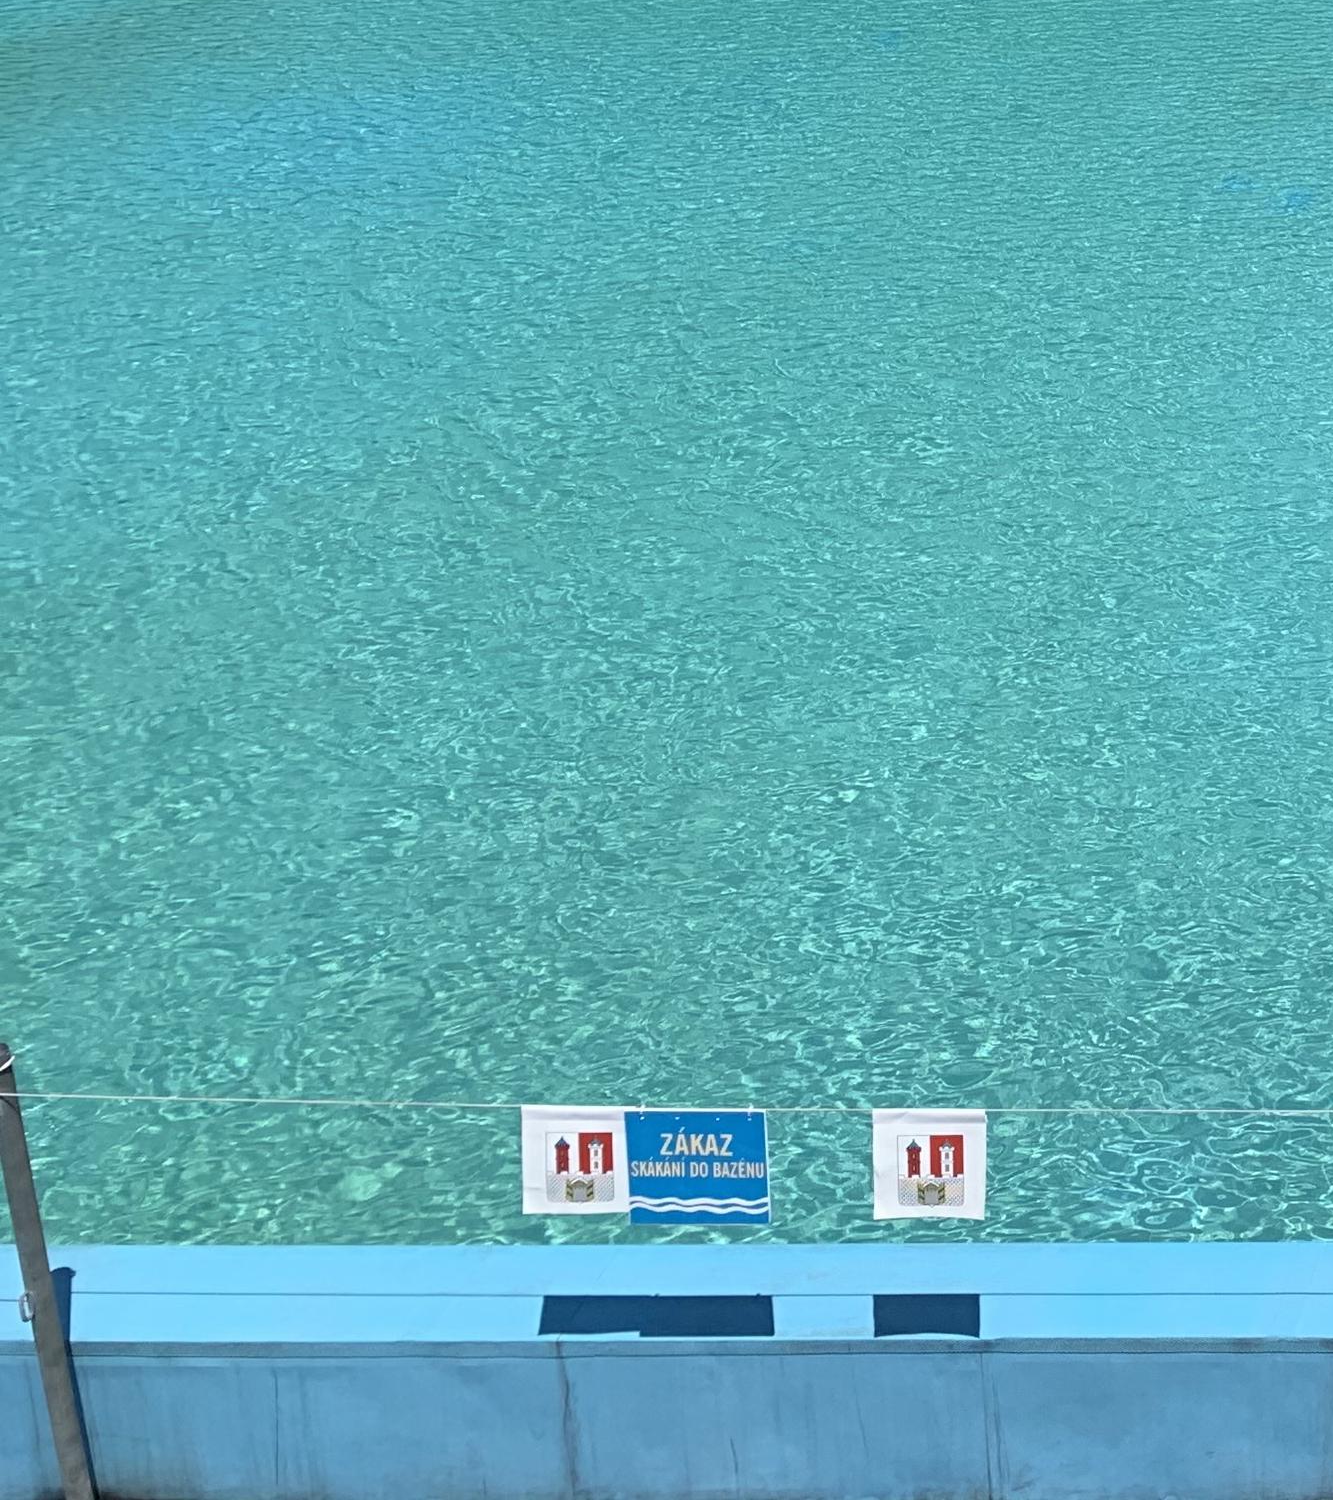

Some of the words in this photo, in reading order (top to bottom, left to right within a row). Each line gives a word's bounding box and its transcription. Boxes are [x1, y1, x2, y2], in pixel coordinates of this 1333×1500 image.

[660, 1127, 733, 1157] ZÁKAZ
[631, 1156, 685, 1178] SKÁKÁNÍ
[690, 1161, 709, 1178] DO
[713, 1158, 764, 1179] BAZÉNU
